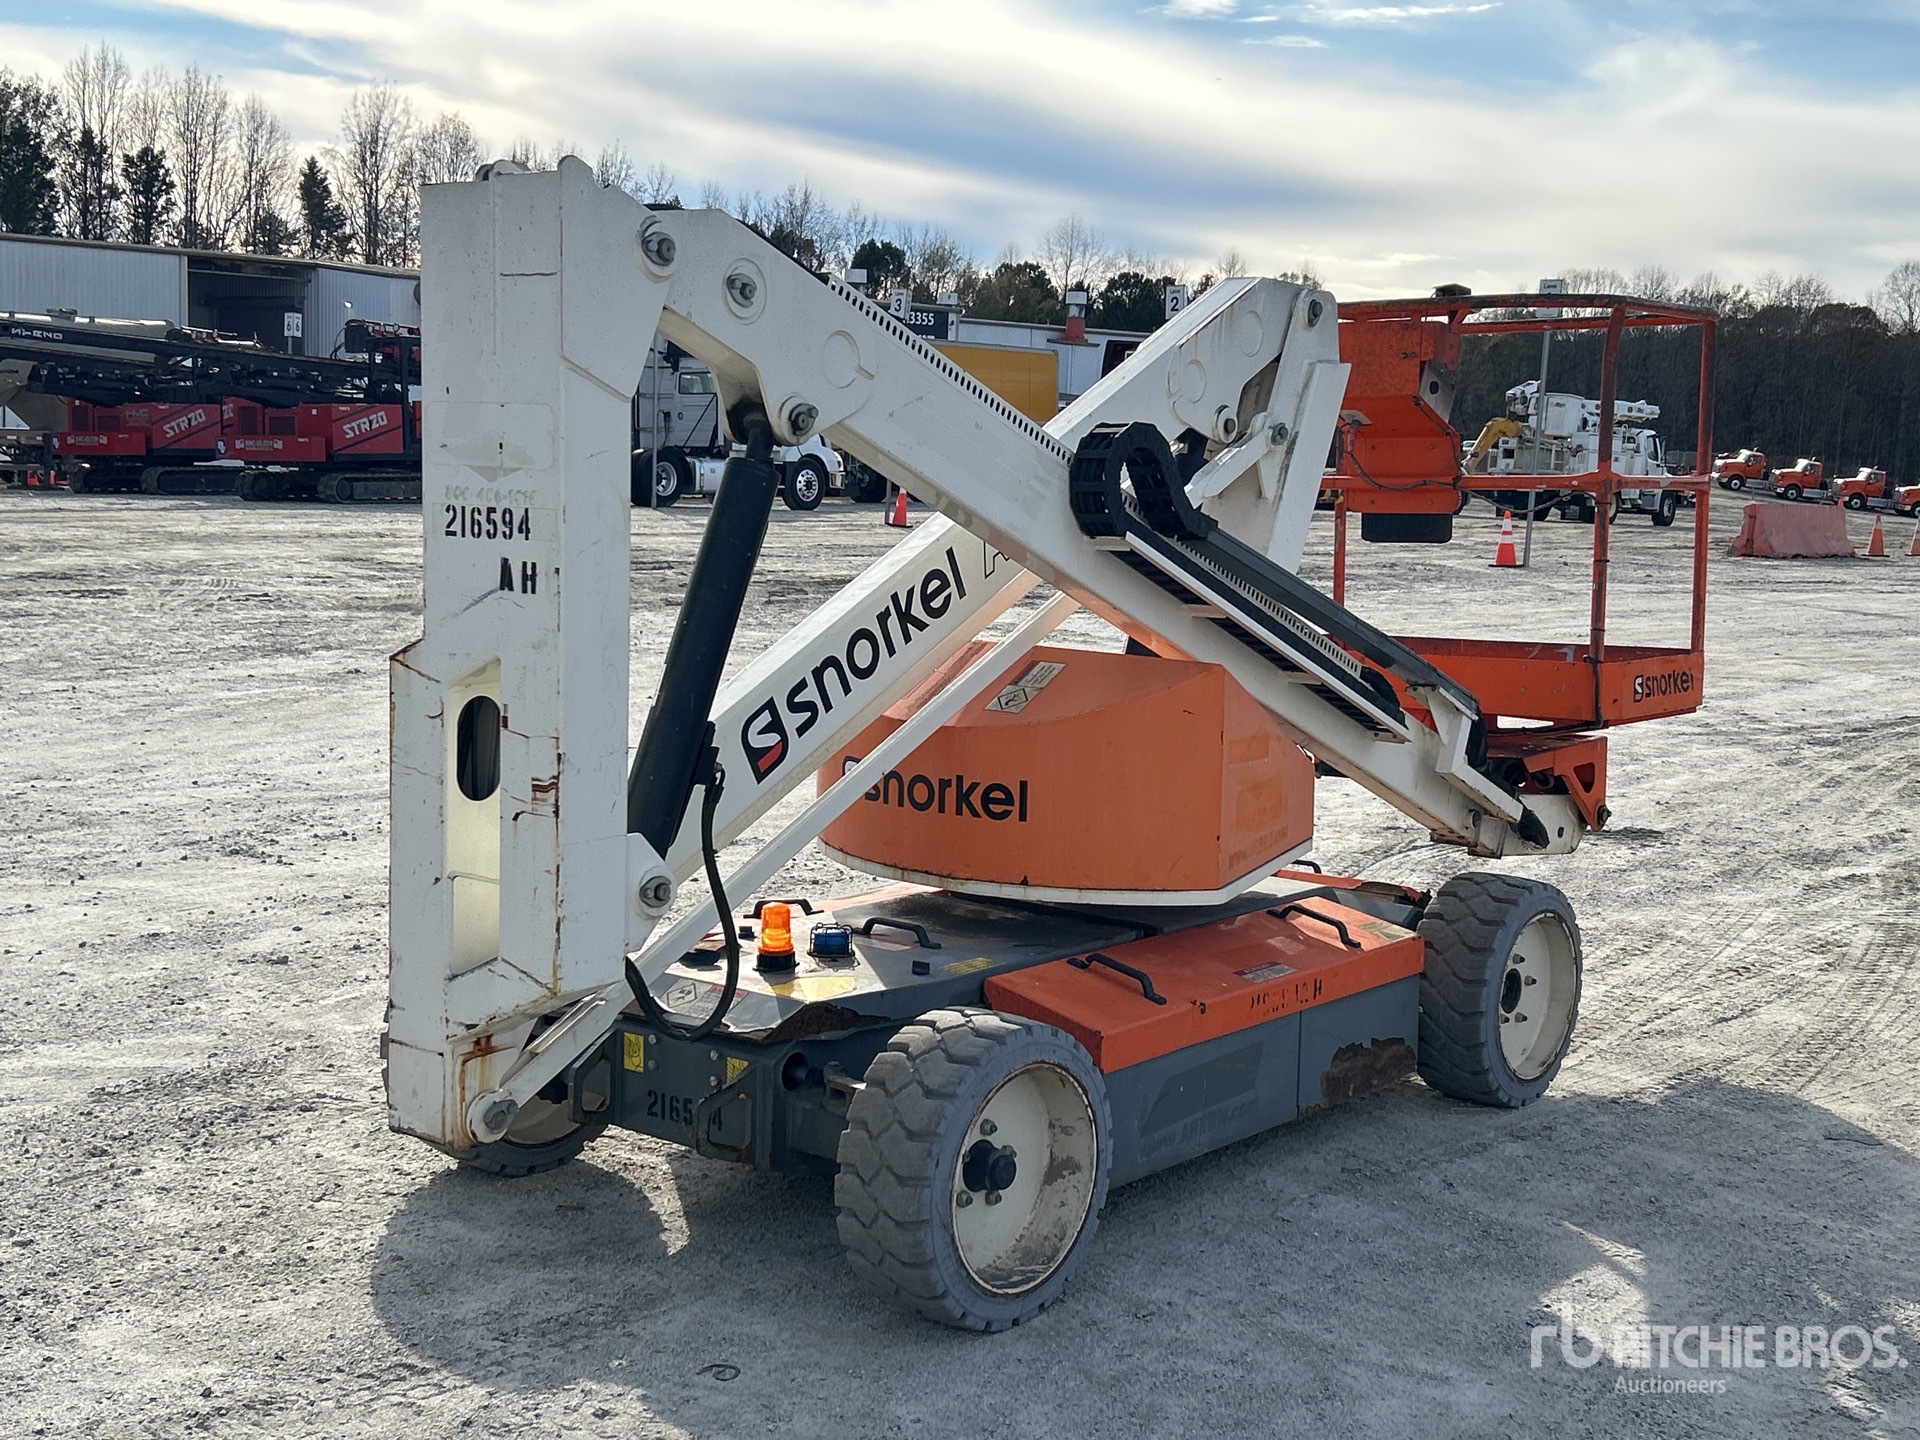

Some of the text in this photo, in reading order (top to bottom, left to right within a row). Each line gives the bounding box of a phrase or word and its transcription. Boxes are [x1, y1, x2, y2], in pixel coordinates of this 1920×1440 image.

[894, 298, 902, 312] 3
[1170, 297, 1179, 312] 2
[286, 321, 292, 332] 6
[295, 321, 300, 332] 6
[445, 504, 531, 541] 216594
[785, 546, 967, 739] snorkel
[1645, 667, 1694, 698] snorkel
[646, 1089, 723, 1132] 21654
